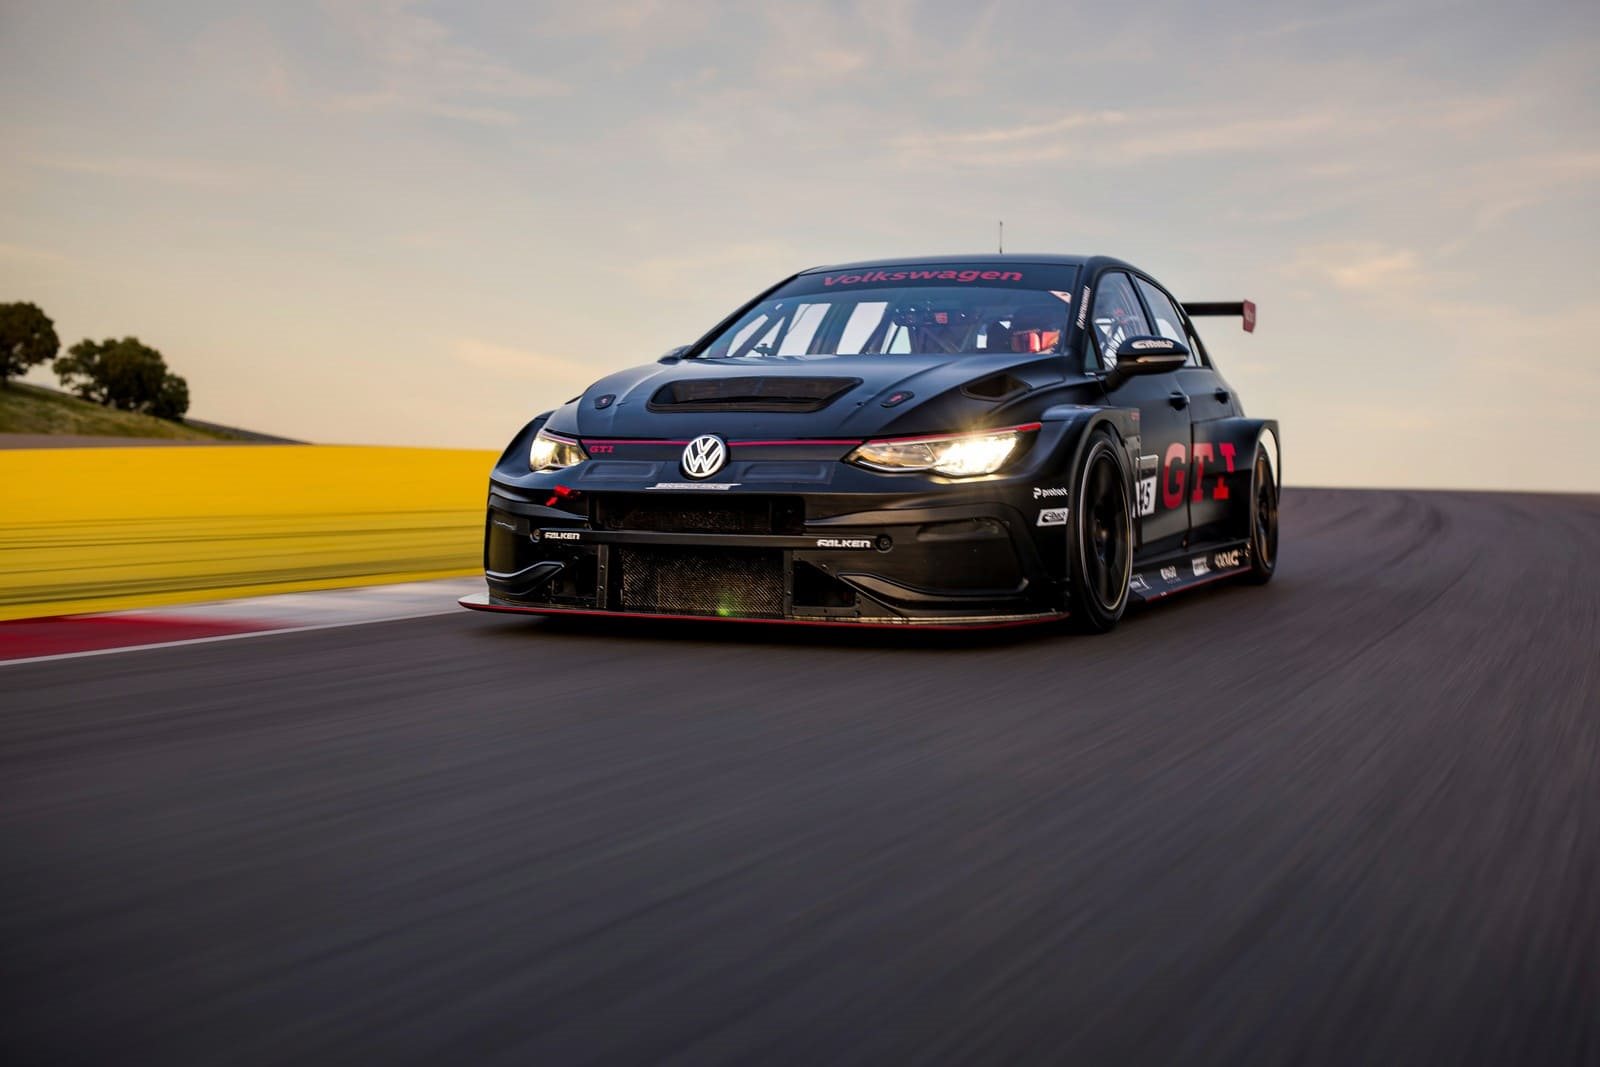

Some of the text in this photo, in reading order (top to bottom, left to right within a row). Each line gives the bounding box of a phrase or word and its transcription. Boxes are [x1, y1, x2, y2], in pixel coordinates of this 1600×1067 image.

[823, 269, 1023, 287] Volkswagen
[589, 445, 614, 453] GTI
[1163, 442, 1237, 510] GTI
[544, 531, 581, 540] FALKEN
[816, 539, 871, 548] FALKEN
